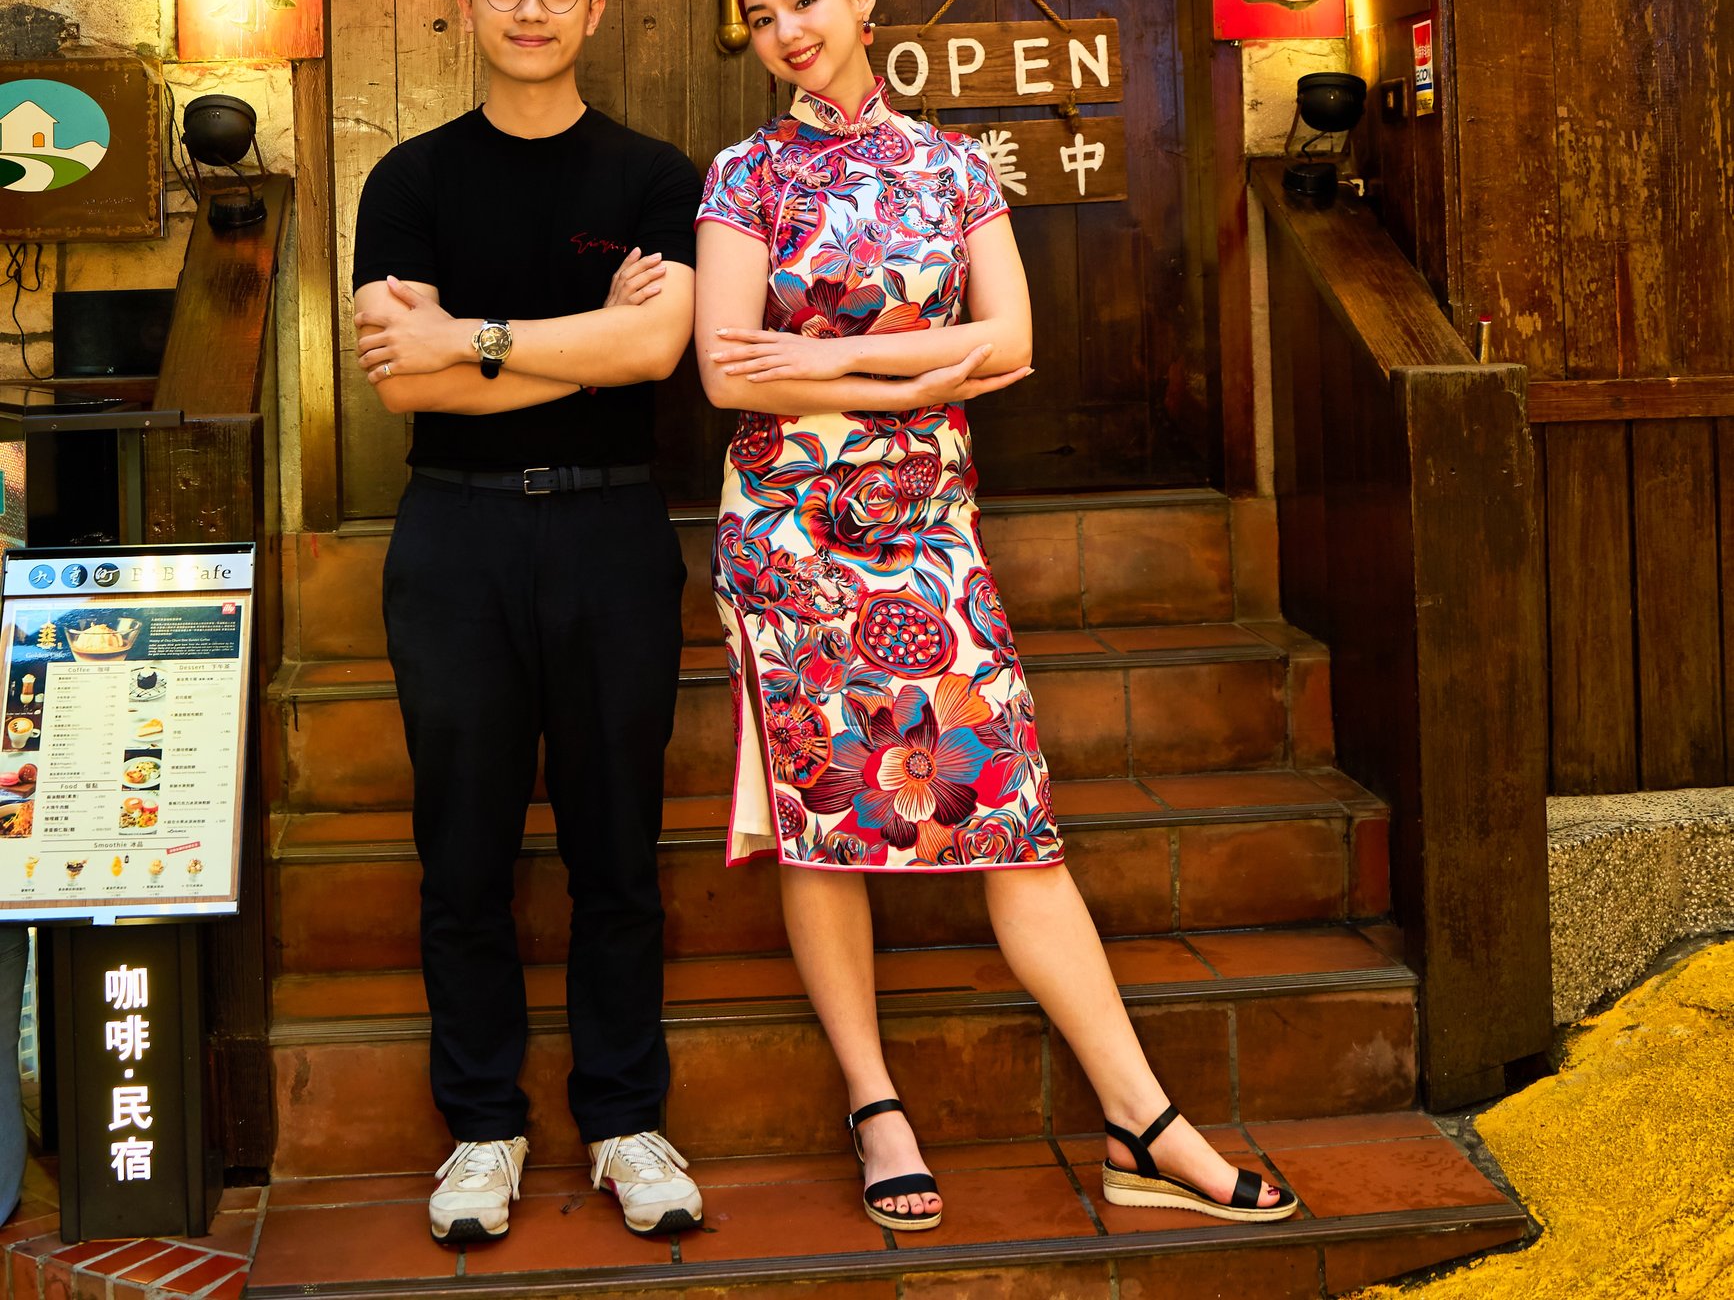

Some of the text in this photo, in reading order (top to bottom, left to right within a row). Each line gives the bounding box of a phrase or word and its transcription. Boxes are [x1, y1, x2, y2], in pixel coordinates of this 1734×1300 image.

[886, 34, 1110, 97] OPEN
[31, 564, 120, 586] 九重町
[94, 840, 128, 849] Smoothie
